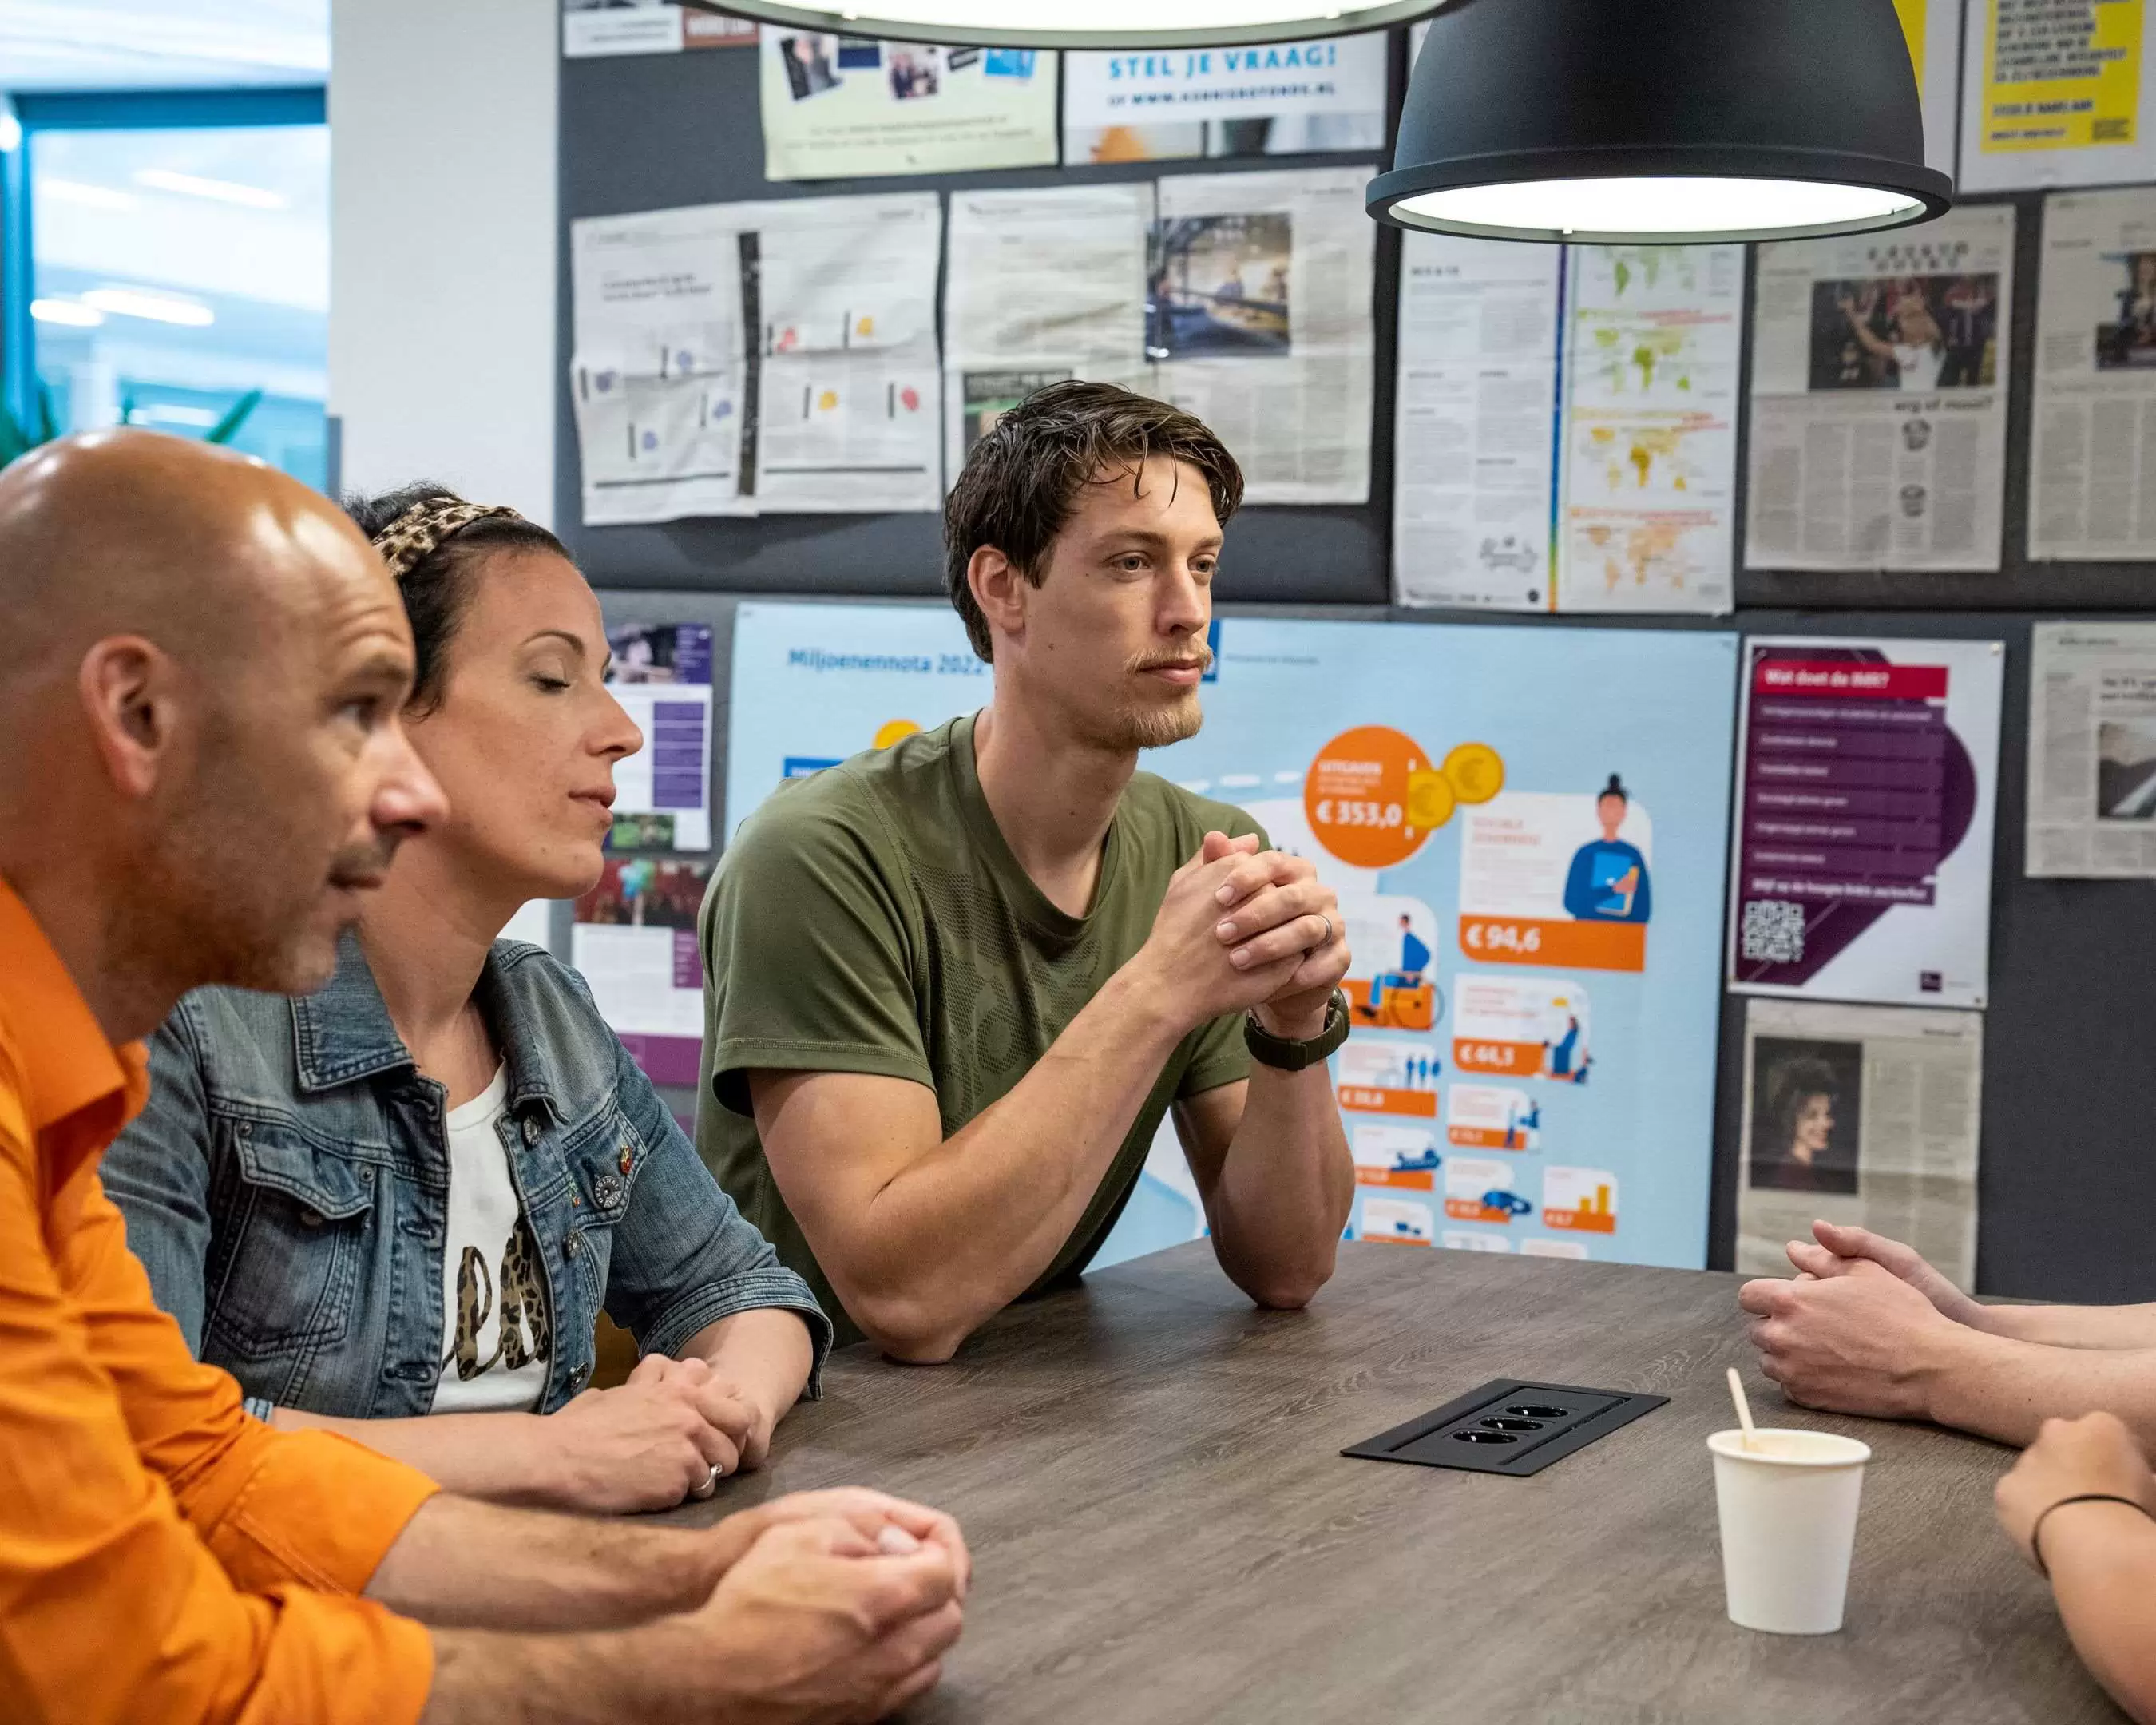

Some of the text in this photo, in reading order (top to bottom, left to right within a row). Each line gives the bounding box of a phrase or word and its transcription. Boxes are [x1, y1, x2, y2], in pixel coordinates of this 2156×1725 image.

[1108, 43, 1338, 79] STEL JE VRAAG!
[787, 648, 932, 673] Miljoenennota
[1765, 668, 1794, 685] Wat
[1795, 669, 1829, 687] doet
[1829, 670, 1849, 687] de
[1316, 799, 1403, 829] € 353,0
[1466, 923, 1542, 954] € 94,6
[1459, 1042, 1473, 1063] €
